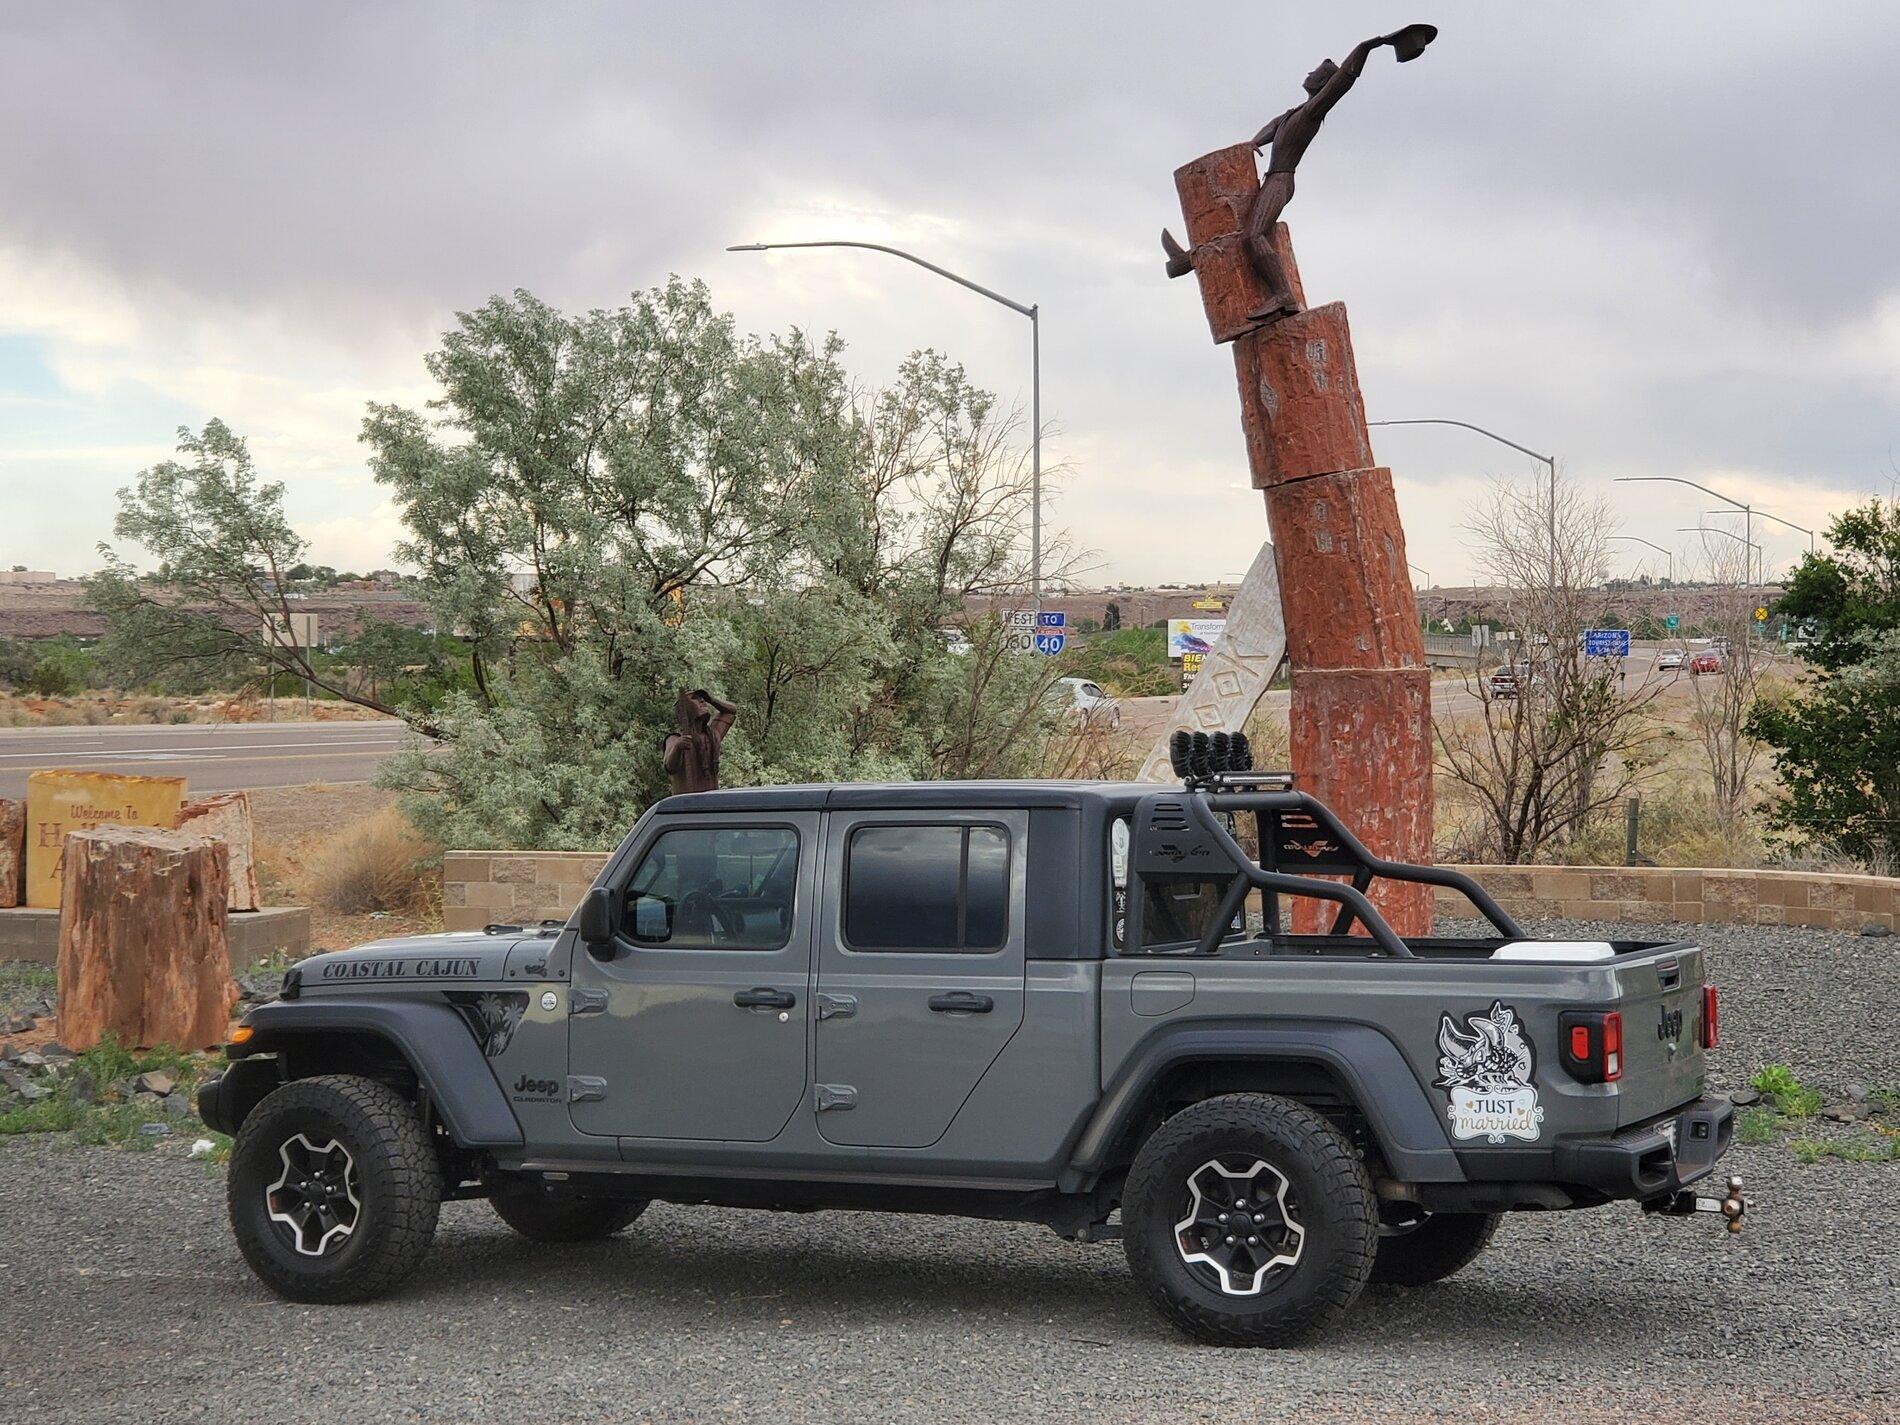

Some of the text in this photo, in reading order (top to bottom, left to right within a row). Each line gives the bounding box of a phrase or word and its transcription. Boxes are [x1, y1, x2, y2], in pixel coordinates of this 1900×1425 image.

[1043, 615, 1058, 625] TO
[1039, 637, 1061, 652] 40
[71, 804, 139, 820] Welcome To
[322, 960, 480, 978] COASTAL CAJUN
[514, 1074, 559, 1097] Jeep
[1474, 1100, 1515, 1114] JUST
[1459, 1109, 1534, 1131] married
